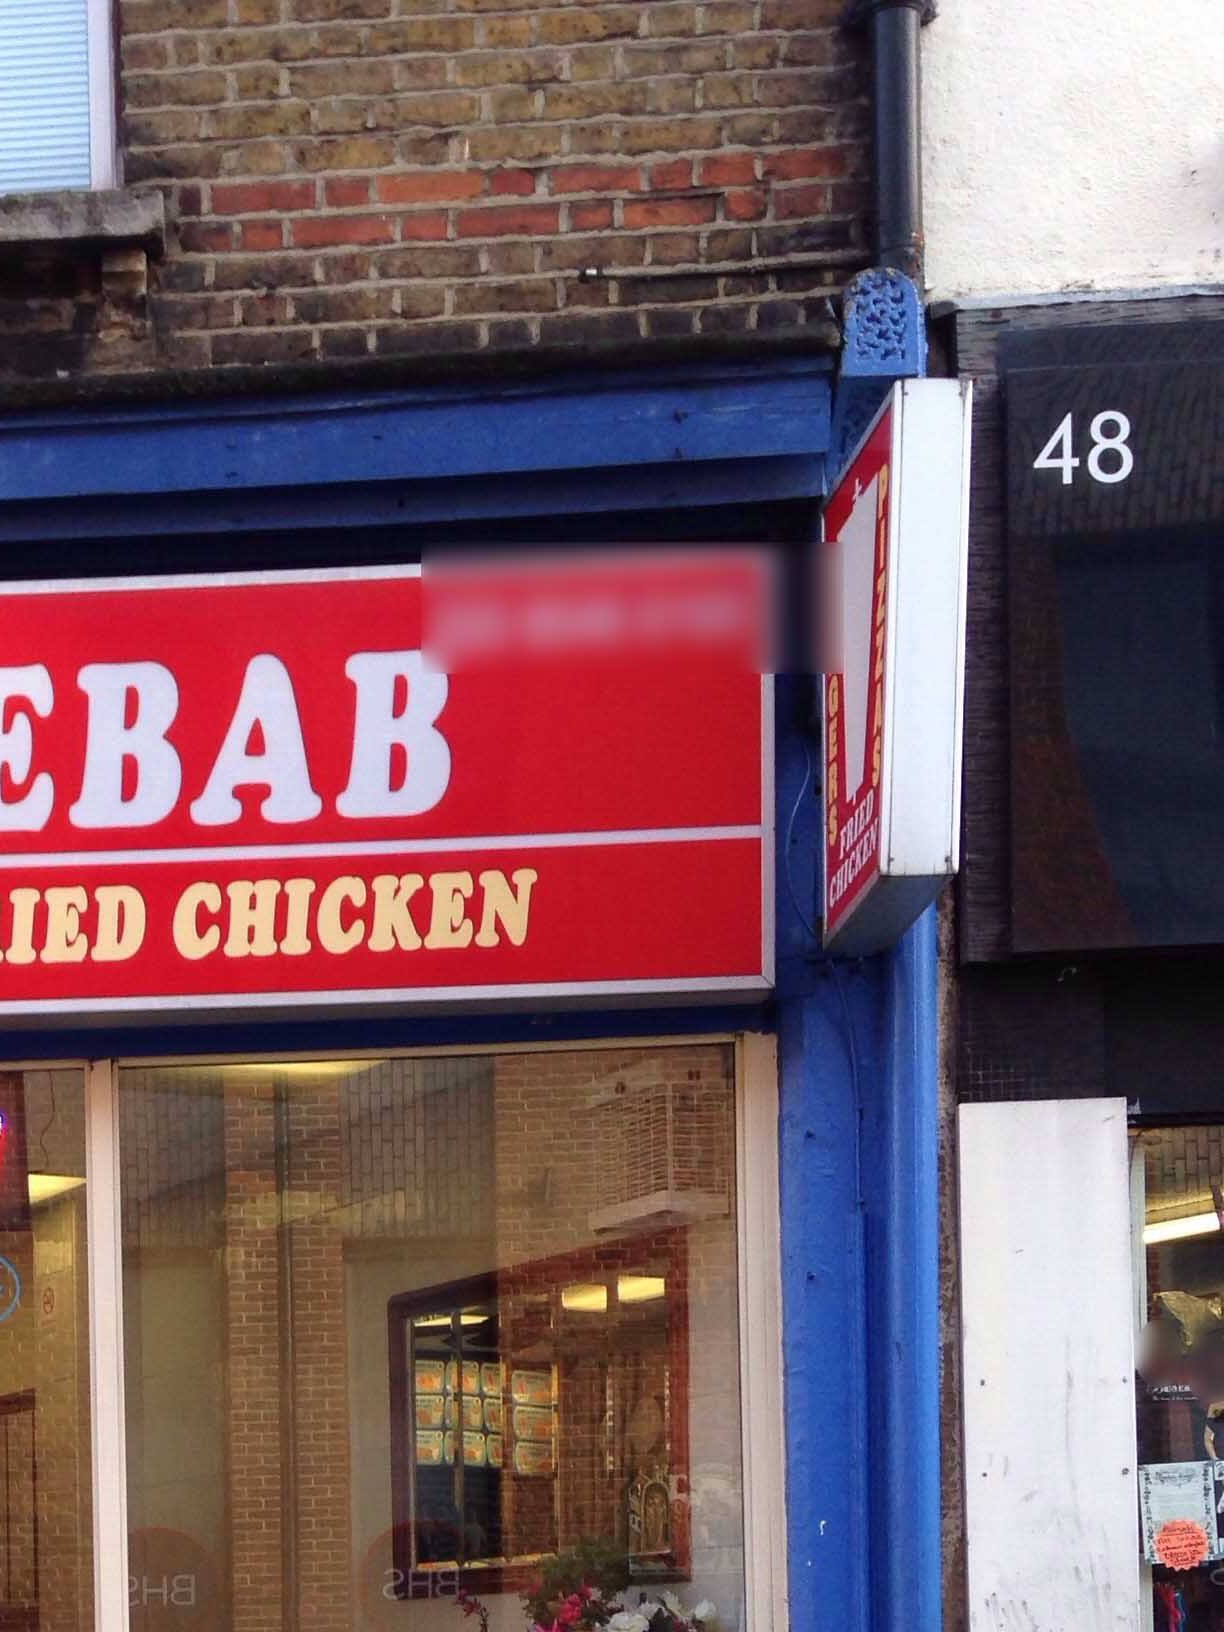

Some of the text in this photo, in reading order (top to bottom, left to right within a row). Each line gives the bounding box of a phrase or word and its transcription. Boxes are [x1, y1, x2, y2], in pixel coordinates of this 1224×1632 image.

[1032, 409, 1134, 486] 48
[828, 815, 880, 909] CHICKEN
[839, 788, 874, 860] FRIED
[173, 868, 539, 960] CHICKEN
